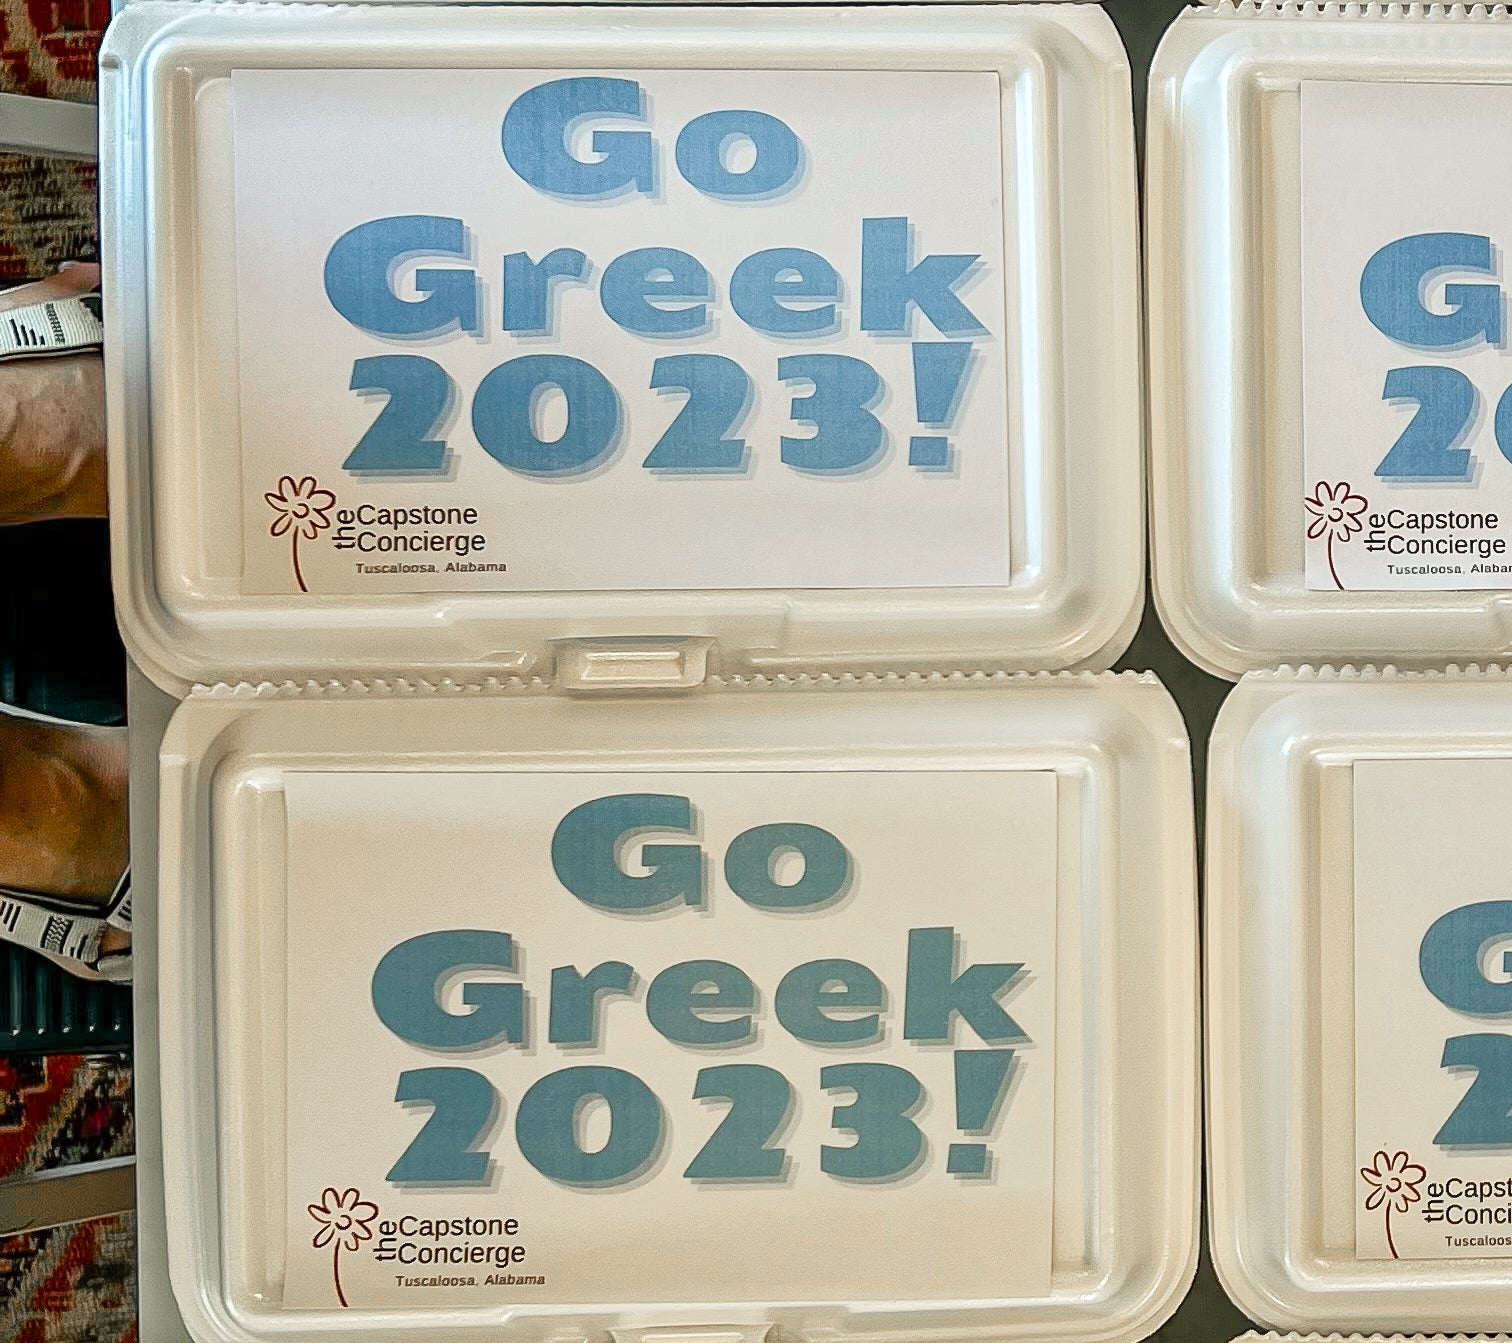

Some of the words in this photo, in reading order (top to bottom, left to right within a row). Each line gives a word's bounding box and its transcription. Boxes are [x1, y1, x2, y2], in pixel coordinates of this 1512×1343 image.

[501, 77, 805, 201] Go
[324, 215, 990, 341] Greek
[341, 342, 975, 478] 2023!
[331, 509, 357, 550] the
[356, 504, 478, 532] Capstone
[1363, 513, 1386, 553] the
[1386, 509, 1499, 535] Capstone
[356, 529, 486, 557] Concierge
[1387, 533, 1506, 559] Concierge
[443, 561, 507, 573] Alabama
[551, 793, 854, 915] Go
[371, 927, 1032, 1053] Greek
[385, 1049, 1021, 1189] 2023!
[1421, 1182, 1445, 1224] the
[371, 1220, 398, 1262] the
[398, 1215, 519, 1242] Capstone
[397, 1241, 526, 1269] Concierge
[483, 1273, 546, 1286] Alabama
